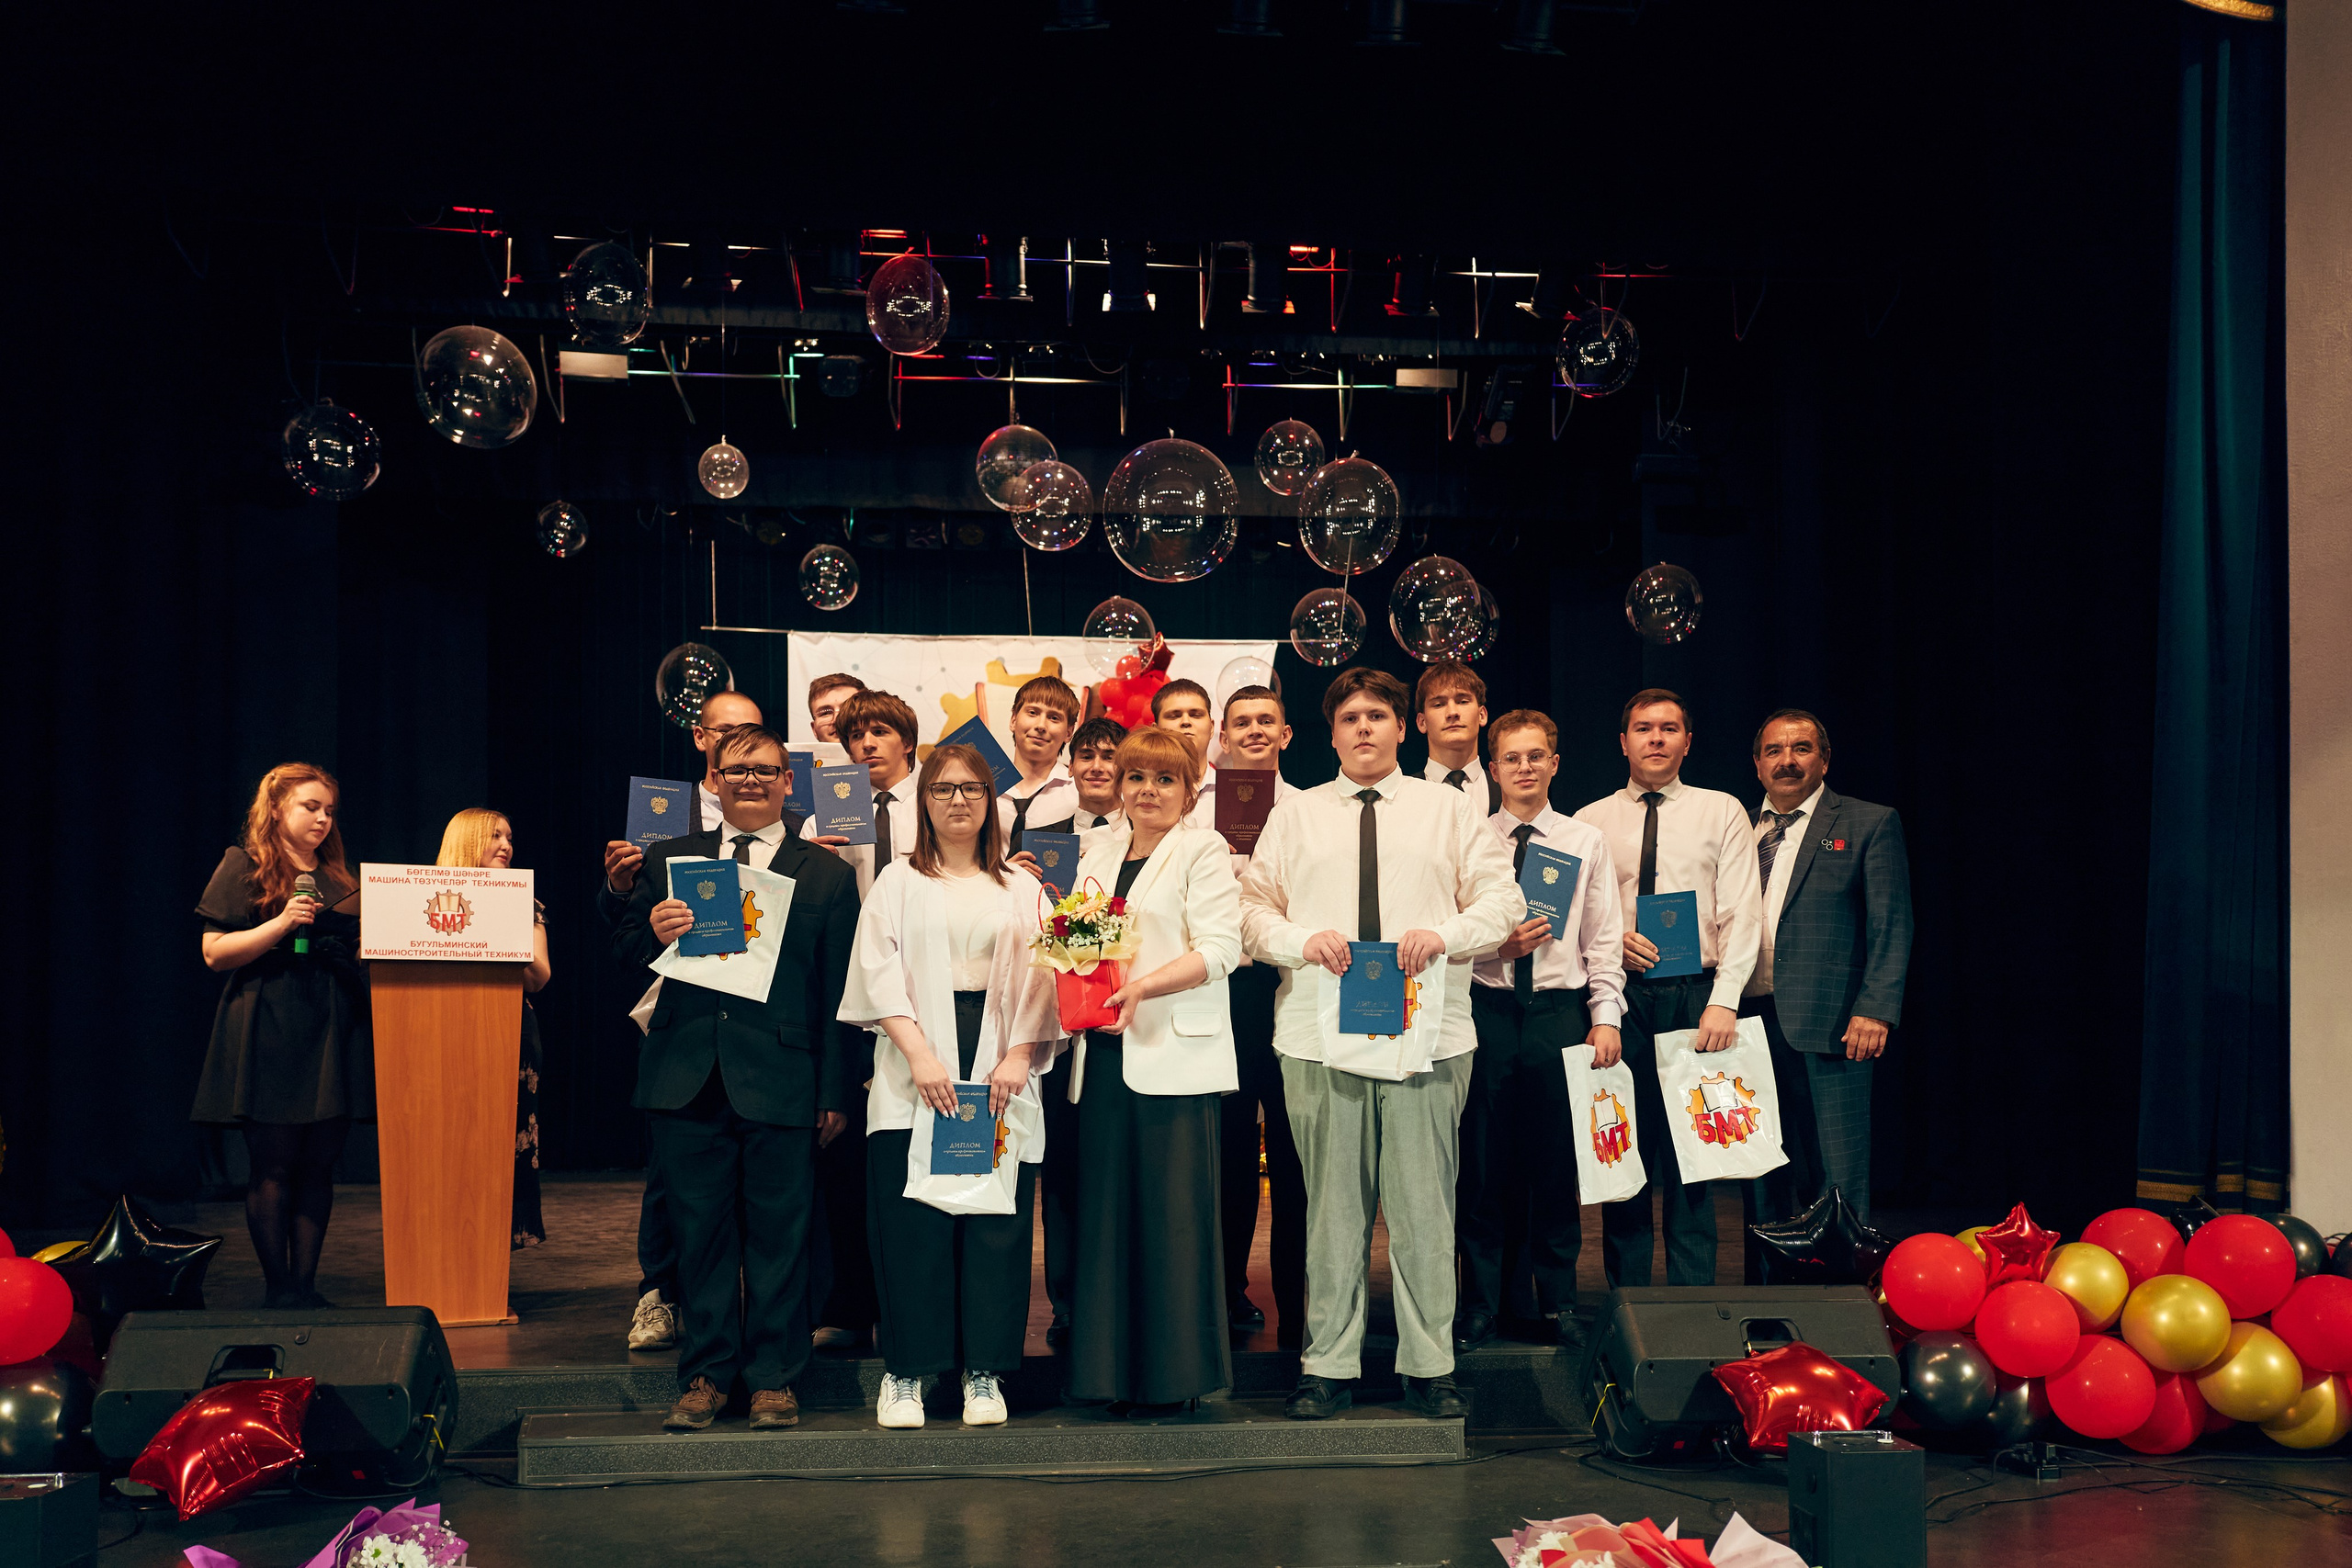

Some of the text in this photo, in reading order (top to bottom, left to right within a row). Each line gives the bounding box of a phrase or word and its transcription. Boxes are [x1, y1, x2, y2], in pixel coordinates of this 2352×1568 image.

[831, 816, 861, 824] ДИПЛОМ
[406, 868, 450, 877] БӨГЕЛМӘ
[368, 875, 411, 885] МАШИНА
[472, 879, 527, 888] ТЕХНИКУМЫ
[1528, 899, 1557, 912] ДИПЛОМ
[430, 913, 467, 931] БМТ
[694, 920, 728, 929] ДИПЛОМ
[410, 940, 488, 949] БУГУЛЬМИНСКИЙ
[365, 949, 531, 959] МАШИНОСТРОИТЕЛЬНЫЙ ТЕХНИКУМ
[1695, 1106, 1755, 1145] БМТ
[1593, 1121, 1629, 1164] БМТ
